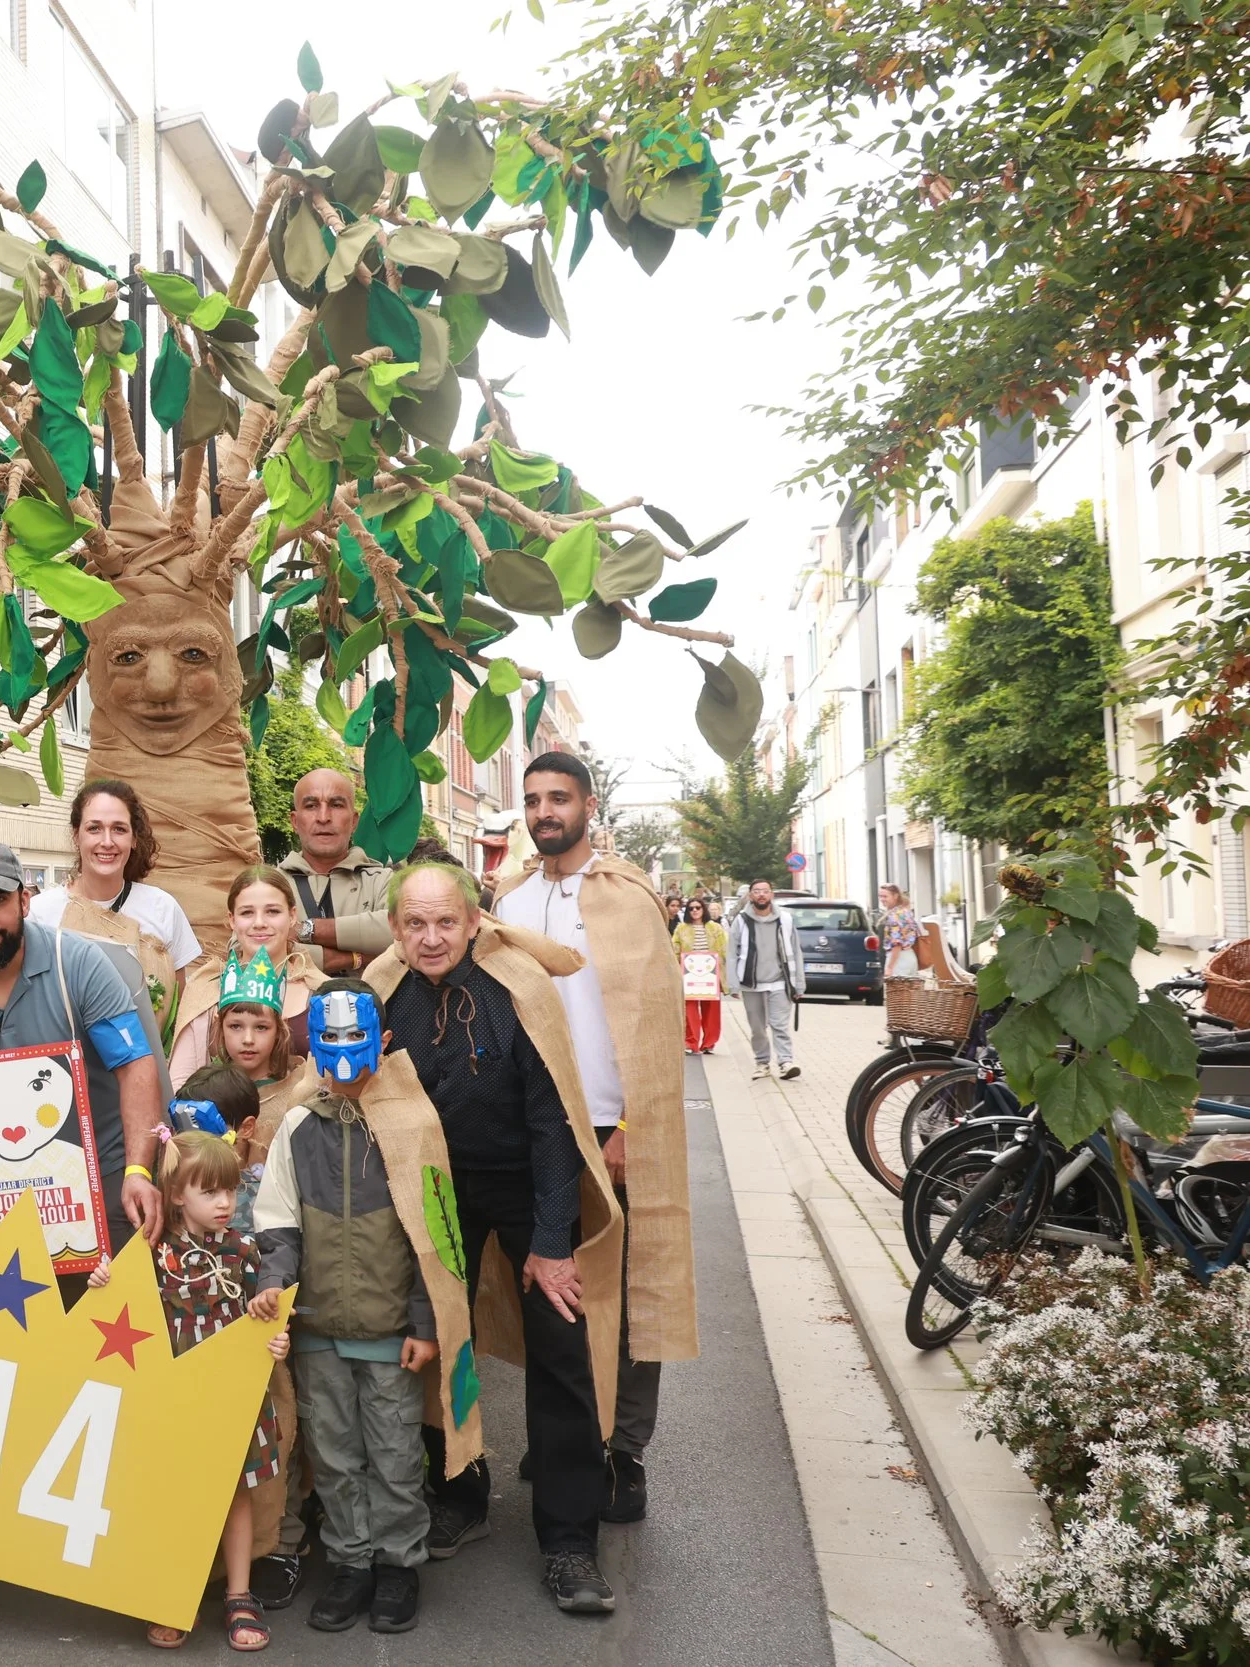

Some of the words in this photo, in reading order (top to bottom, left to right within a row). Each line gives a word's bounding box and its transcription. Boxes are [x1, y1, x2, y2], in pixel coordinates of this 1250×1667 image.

[246, 980, 273, 1002] 314
[19, 1177, 52, 1188] DISTRICT
[35, 1188, 65, 1208] VAN
